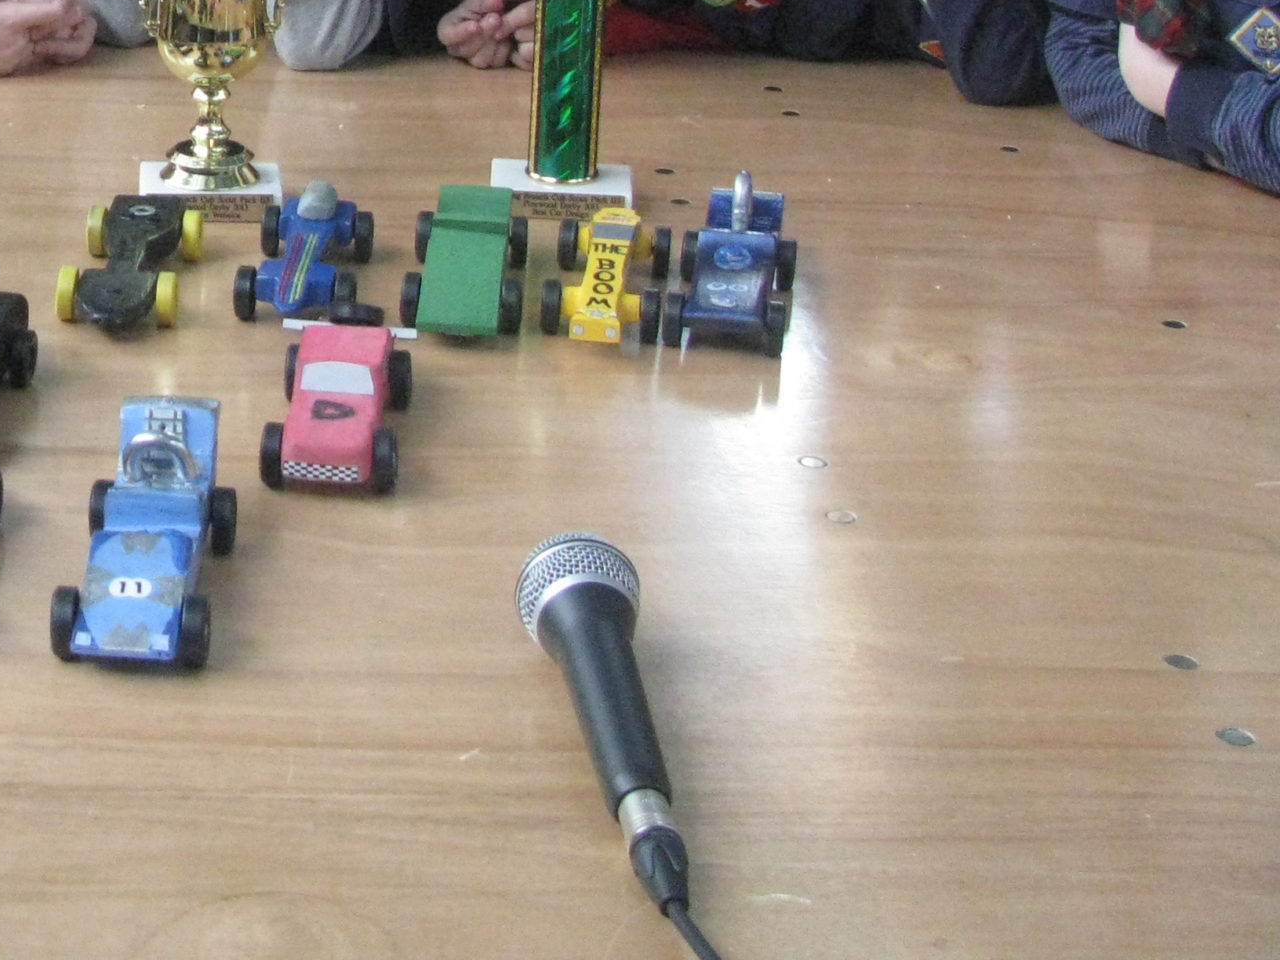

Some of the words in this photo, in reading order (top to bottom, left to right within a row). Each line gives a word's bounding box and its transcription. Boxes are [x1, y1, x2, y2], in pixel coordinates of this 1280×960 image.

[593, 242, 628, 255] THE
[586, 258, 615, 308] BOOM
[120, 581, 142, 594] 11
